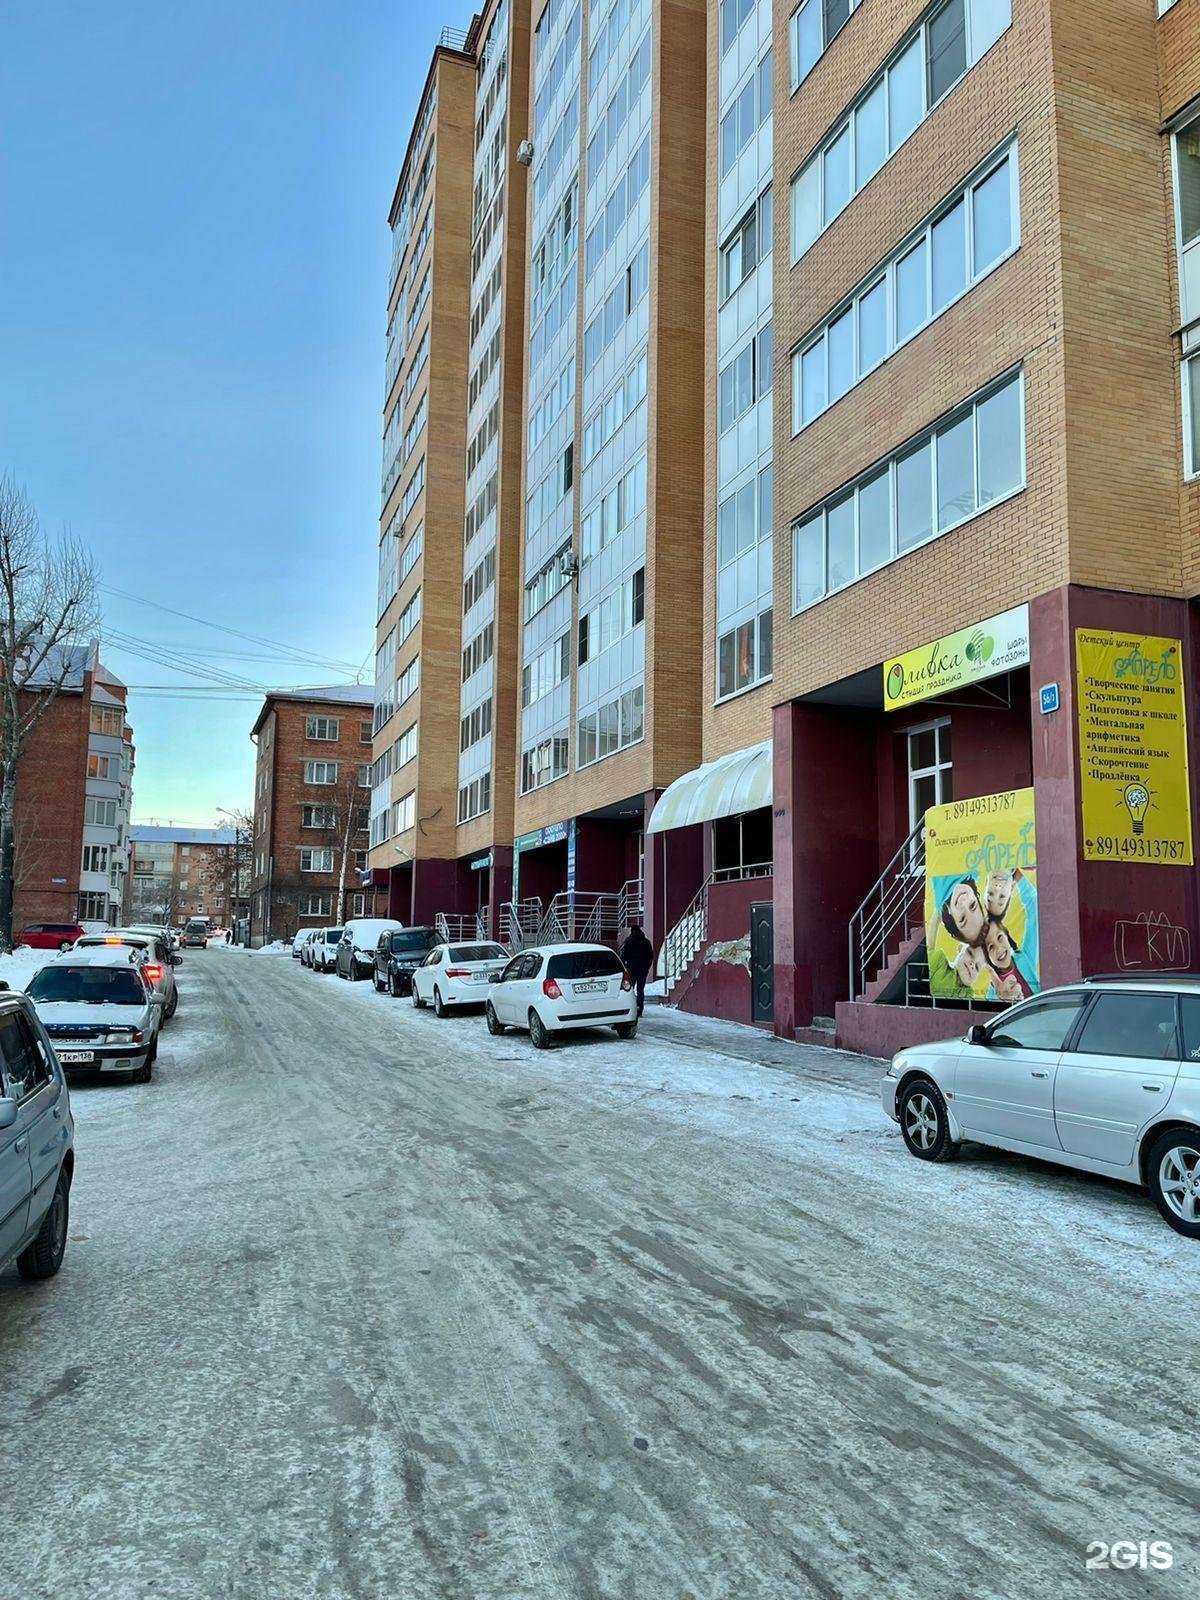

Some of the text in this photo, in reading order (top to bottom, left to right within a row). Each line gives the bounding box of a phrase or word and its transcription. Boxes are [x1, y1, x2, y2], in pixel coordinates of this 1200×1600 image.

[887, 642, 964, 700] Оливка
[1088, 677, 1175, 695] Творческие занятия
[1089, 690, 1142, 705] Скульптура
[1089, 703, 1139, 717] Подготовка
[1150, 711, 1178, 720] школе
[1090, 716, 1145, 730] Ментальная
[1086, 731, 1141, 743] арифметика
[1091, 744, 1170, 758] Английский язык
[1091, 756, 1149, 770] Скорочтение
[953, 792, 1016, 820] 89149313787
[1096, 836, 1185, 859] 89149313787
